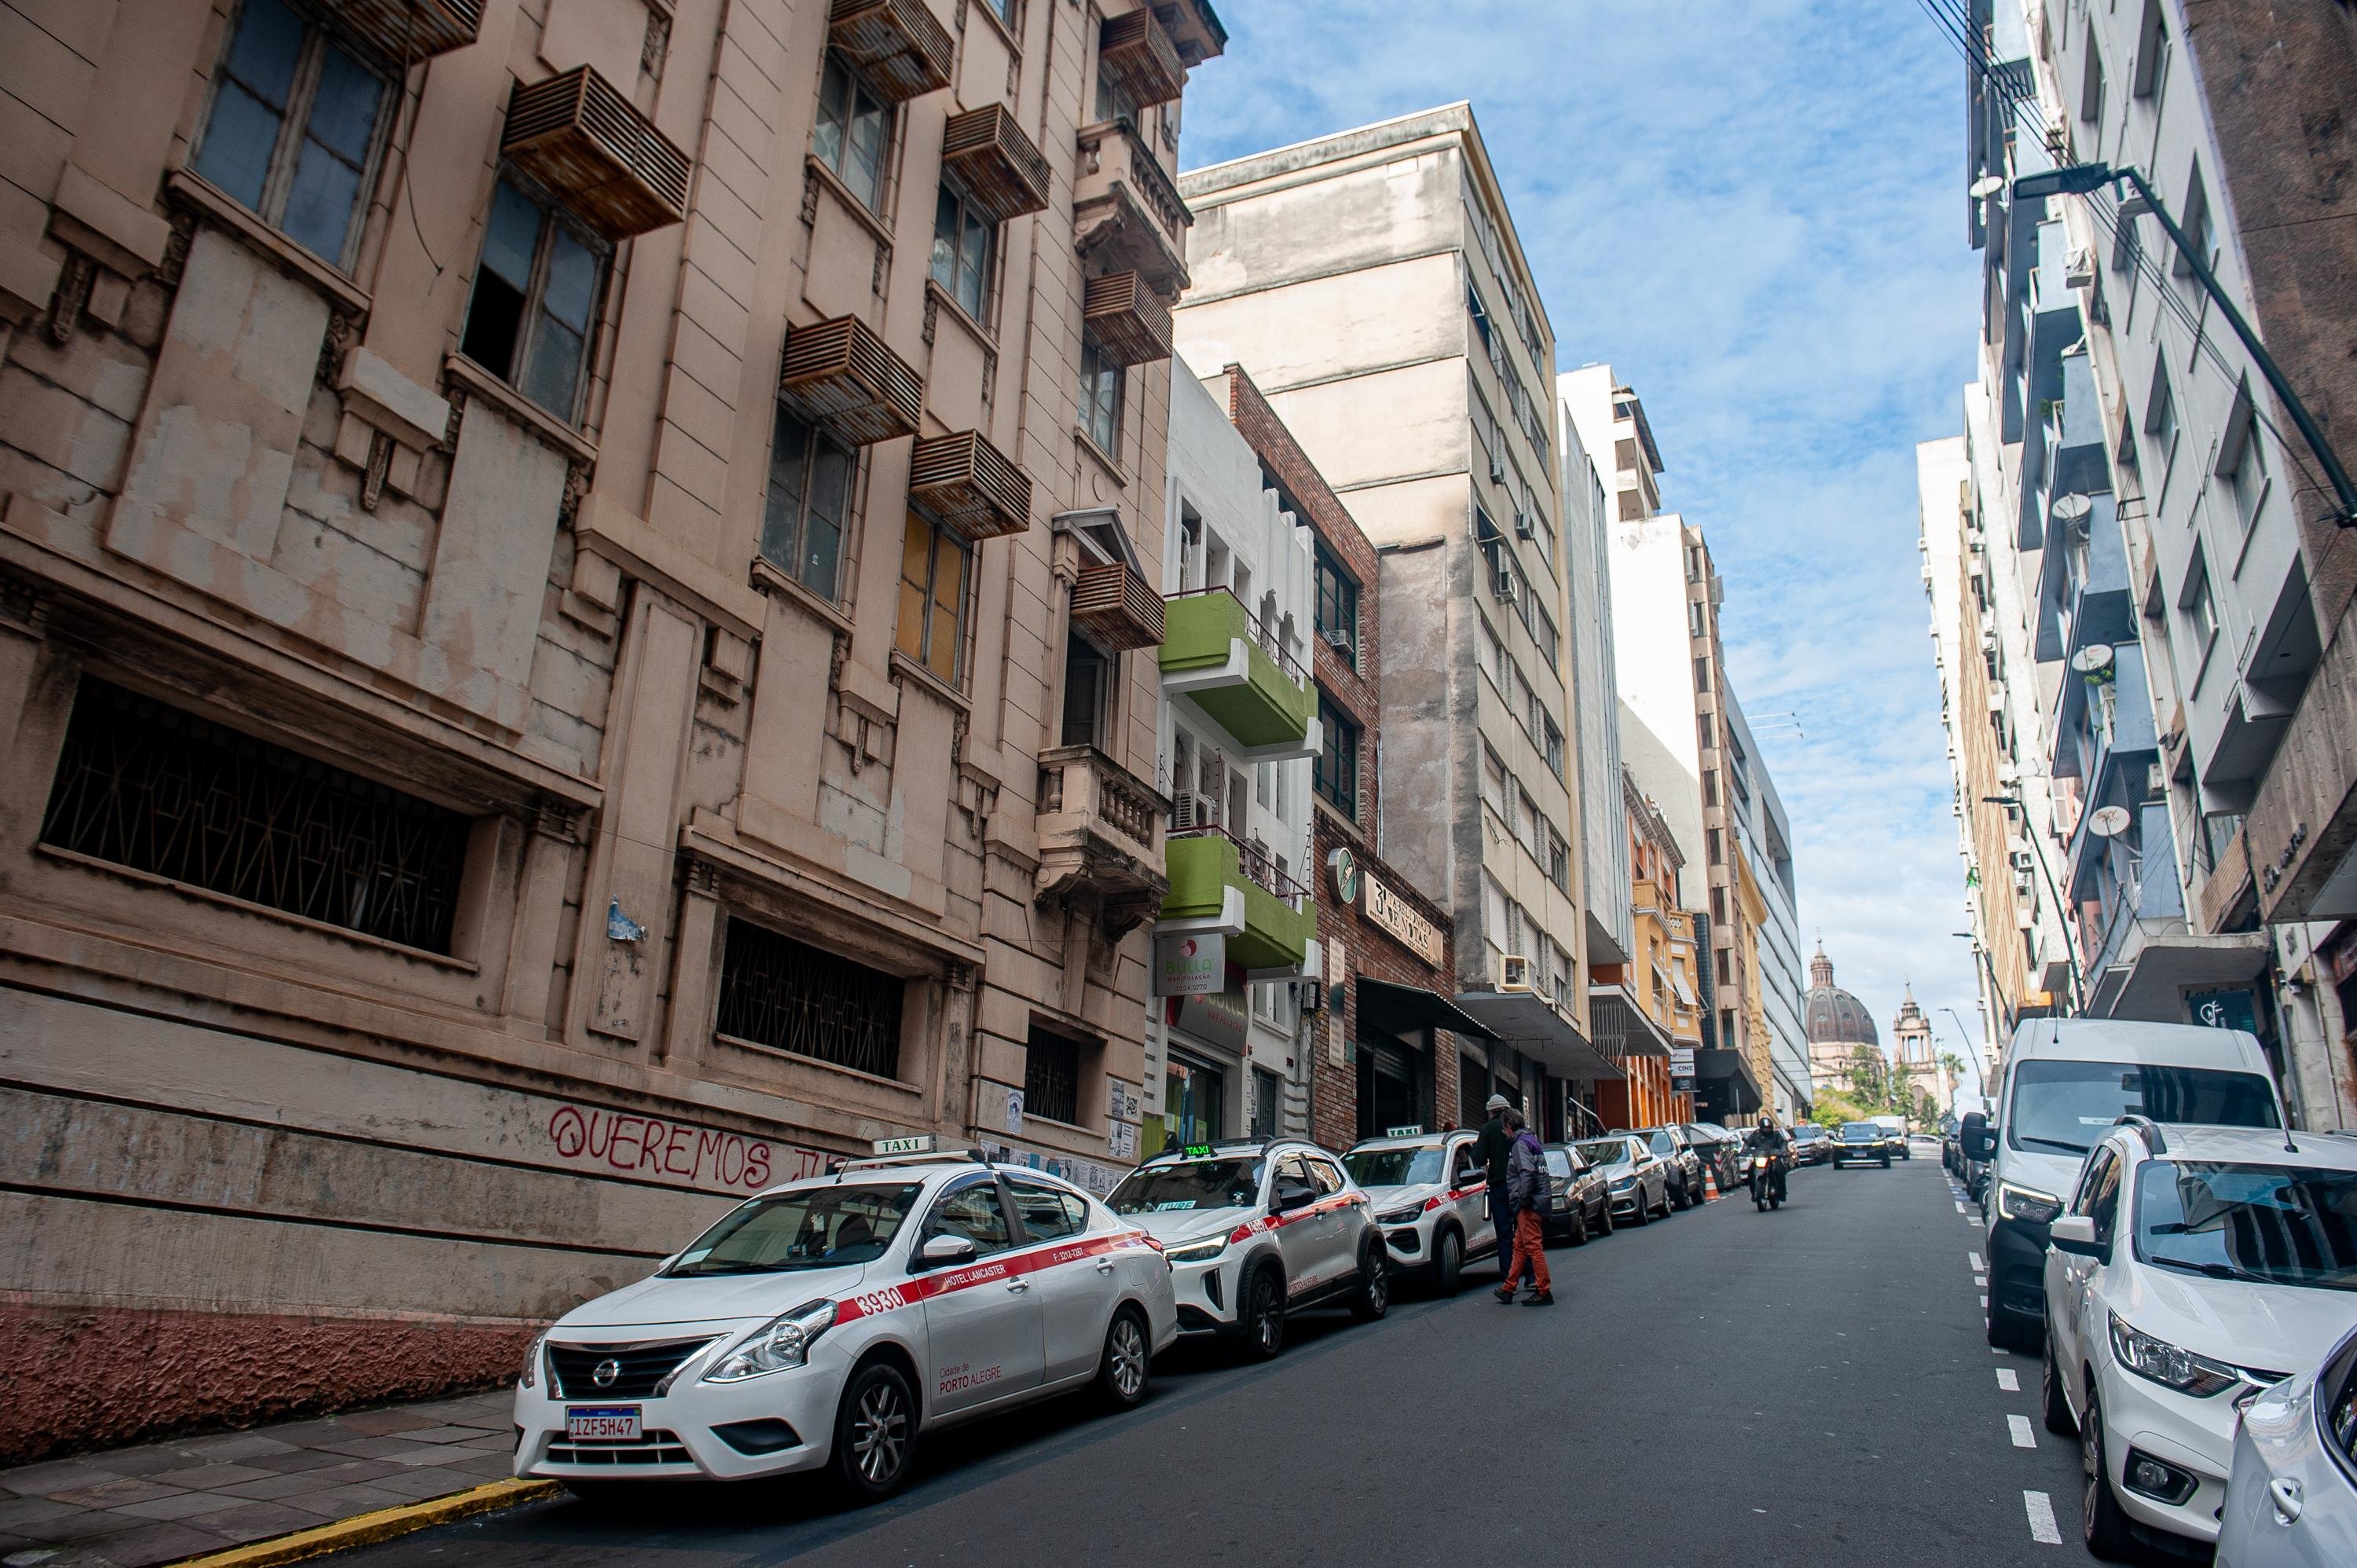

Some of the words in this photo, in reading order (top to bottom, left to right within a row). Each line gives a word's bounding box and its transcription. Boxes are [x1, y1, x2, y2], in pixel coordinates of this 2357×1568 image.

[1388, 892, 1431, 936] TABELIONATO
[1387, 904, 1398, 928] DE
[1401, 916, 1428, 949] NOTAS
[1166, 959, 1211, 974] BULLA
[1175, 984, 1208, 992] 3224.0770
[1389, 1128, 1418, 1137] TAXI
[549, 1106, 771, 1189] QUEREMOS
[882, 1138, 919, 1152] TAXI
[1186, 1145, 1209, 1155] TAXI
[944, 1273, 970, 1288] HOTEL
[967, 1264, 1006, 1282] LANCASTER
[856, 1287, 904, 1316] 3930
[940, 1364, 962, 1379] Cidade
[961, 1361, 970, 1372] de
[940, 1376, 969, 1395] PORTO
[970, 1365, 1002, 1387] ALEGRE
[574, 1418, 633, 1436] IZF5H47
